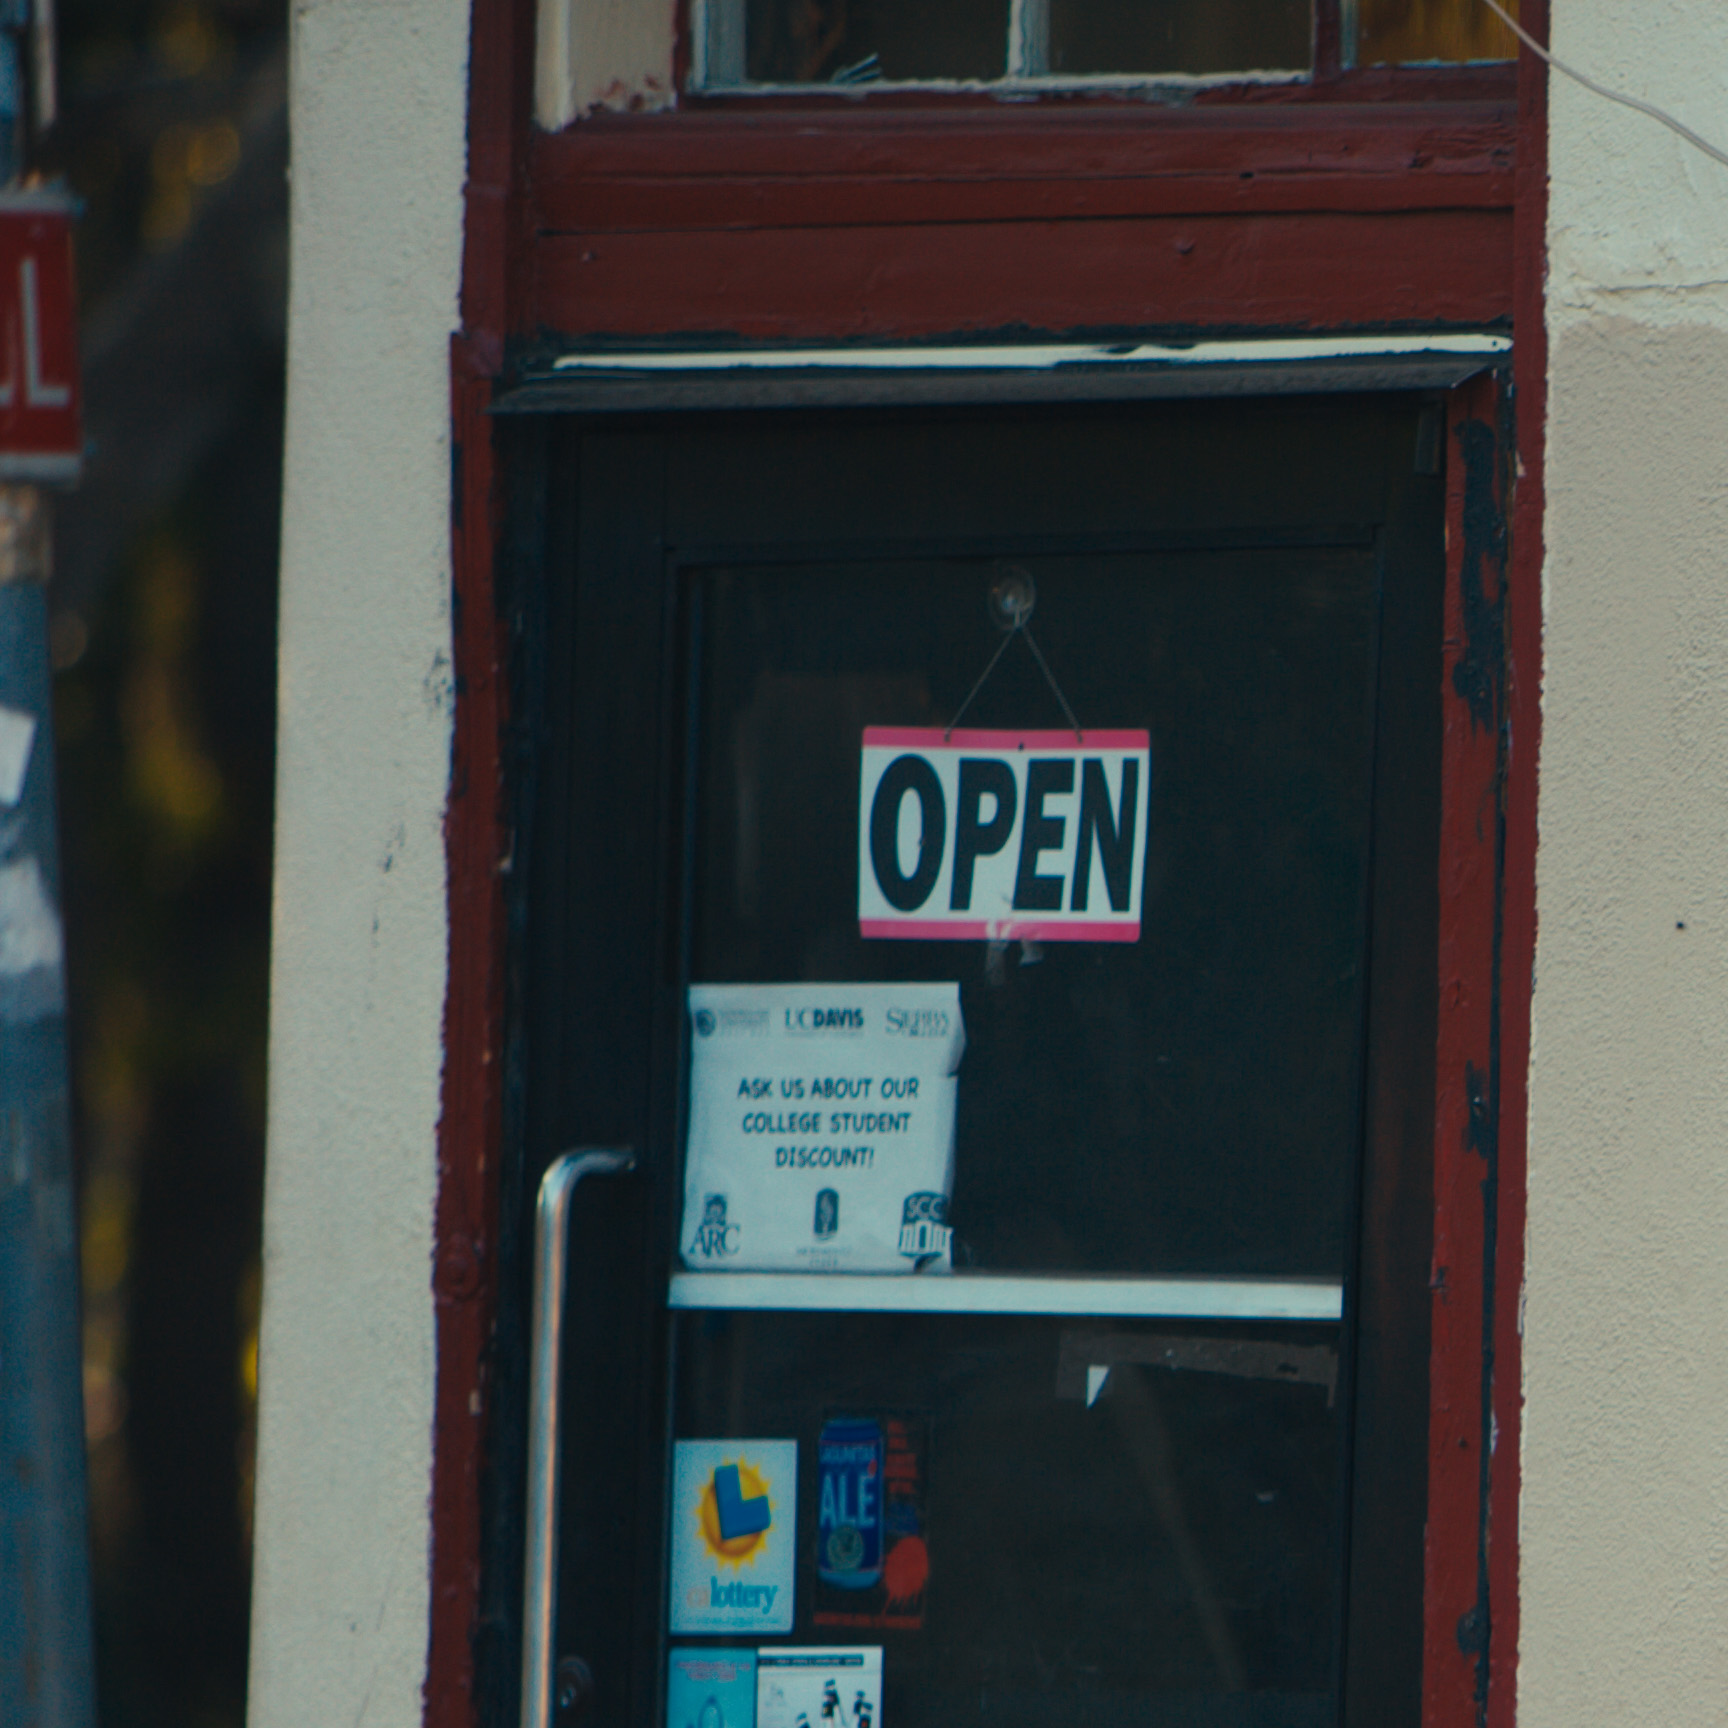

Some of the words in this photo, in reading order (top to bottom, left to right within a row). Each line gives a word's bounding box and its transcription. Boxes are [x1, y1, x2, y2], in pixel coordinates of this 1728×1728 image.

[870, 754, 1139, 913] OPEN
[738, 1077, 773, 1098] ASK
[780, 1077, 804, 1099] US
[811, 1077, 872, 1099] ABOUT
[881, 1077, 919, 1099] OUR
[742, 1112, 821, 1134] COLLEGE
[830, 1112, 911, 1133] STUDENT
[775, 1146, 874, 1168] DISCOUNT!
[907, 1197, 944, 1220] SCC
[689, 1223, 741, 1258] ARC
[820, 1474, 875, 1529] ALE
